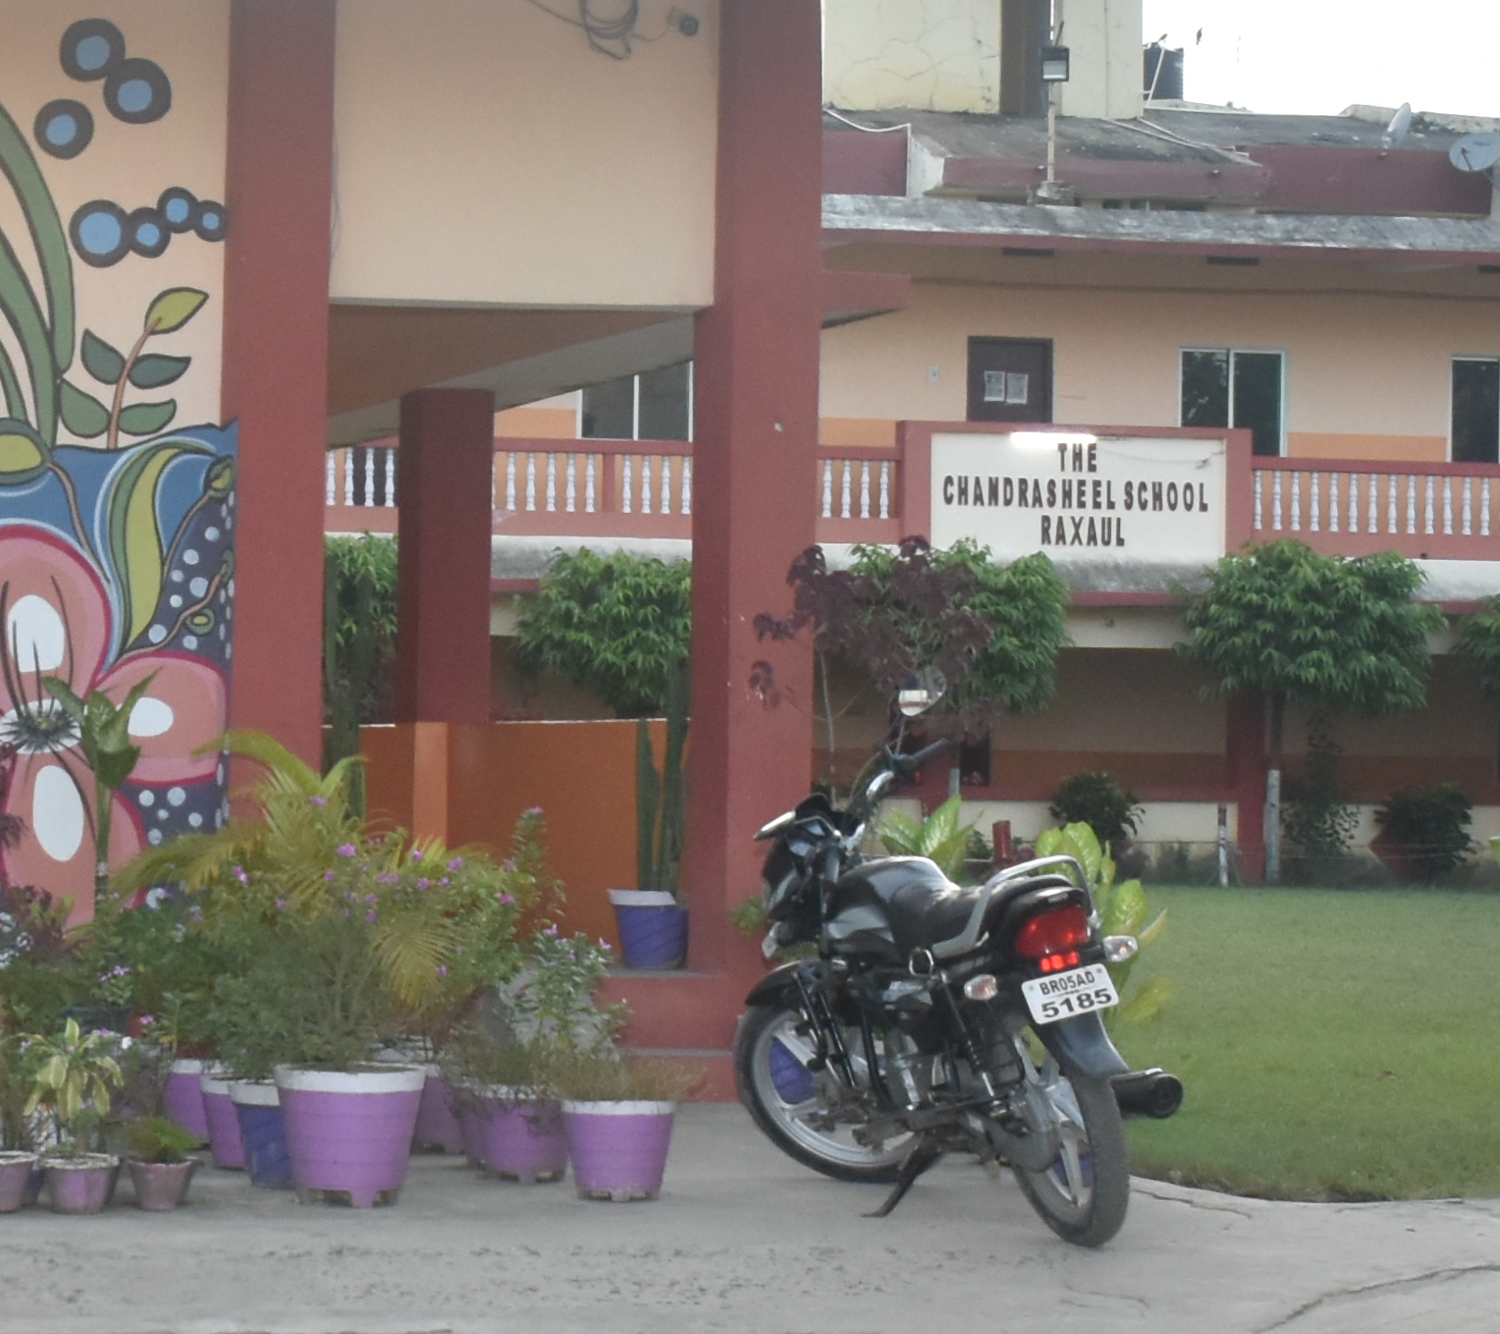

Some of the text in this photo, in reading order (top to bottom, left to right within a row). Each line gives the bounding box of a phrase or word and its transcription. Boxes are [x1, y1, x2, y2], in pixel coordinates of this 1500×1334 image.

[1058, 442, 1097, 472] THE
[943, 474, 1209, 512] CHANDRASHEEL SCHOOL
[1040, 515, 1126, 547] RAXAUL
[1039, 970, 1096, 995] BR05AD
[1041, 988, 1112, 1018] 5185
